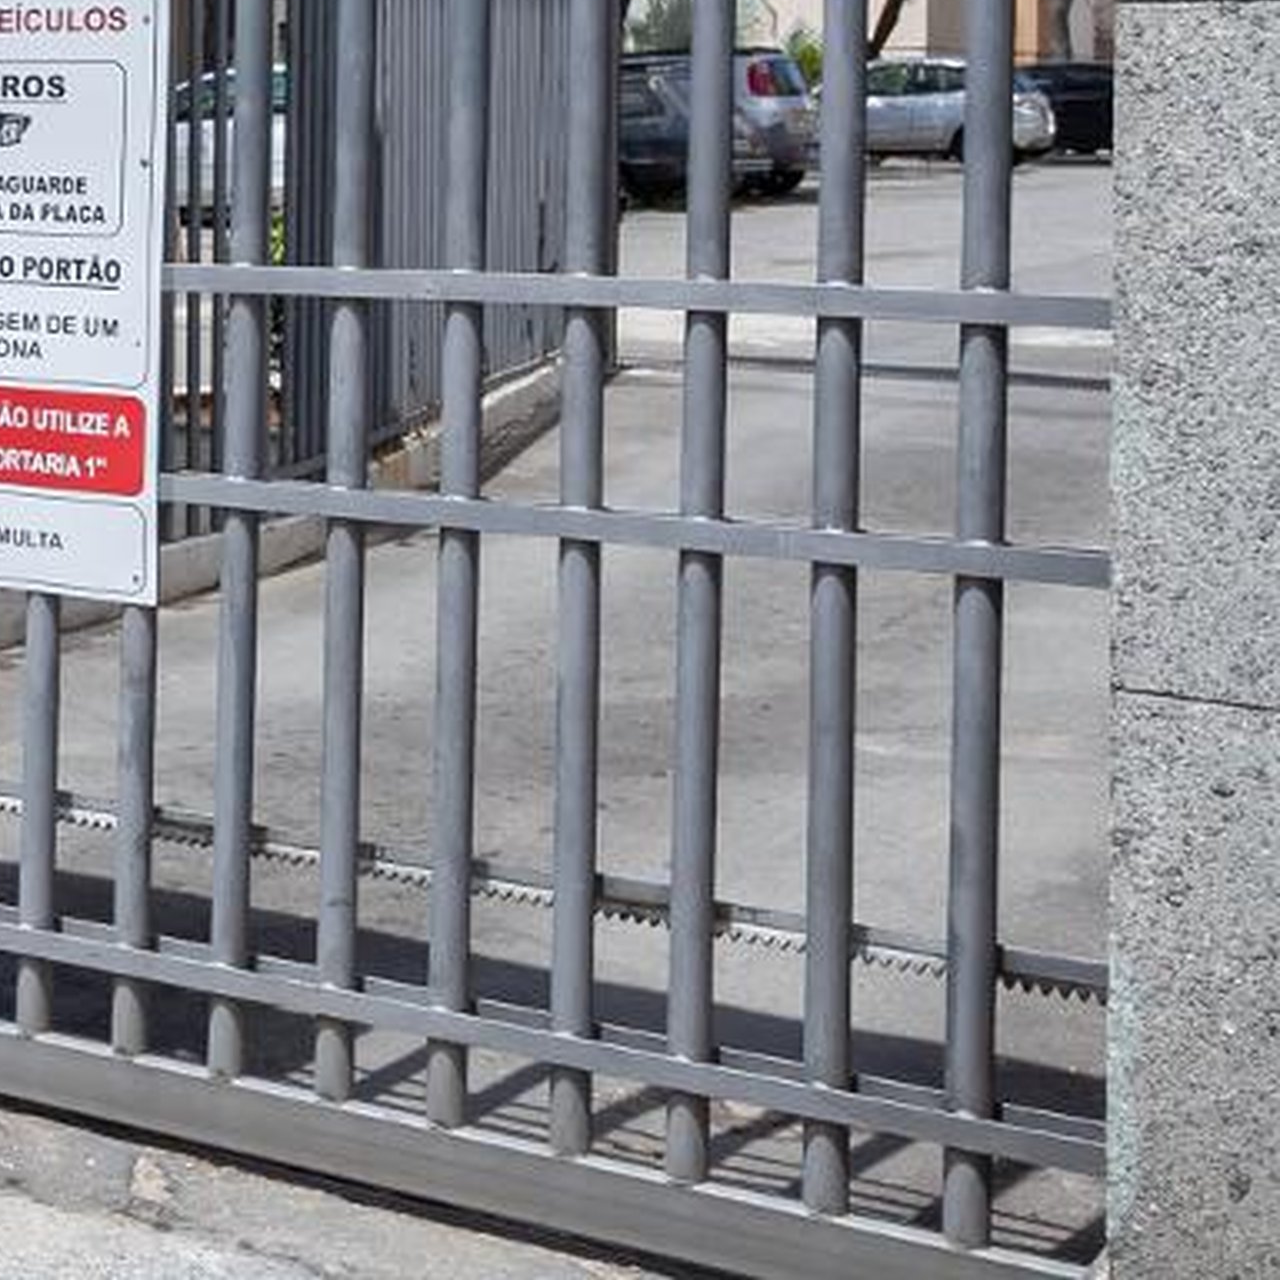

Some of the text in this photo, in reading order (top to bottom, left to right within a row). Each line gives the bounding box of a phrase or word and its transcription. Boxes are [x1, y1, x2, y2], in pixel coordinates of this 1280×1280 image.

[9, 203, 35, 222] DA
[41, 203, 107, 224] PLACA
[22, 254, 122, 284] PORTÃO
[46, 315, 77, 335] DE
[83, 317, 119, 338] UM
[33, 408, 109, 436] UTILIZE
[114, 414, 130, 439] A
